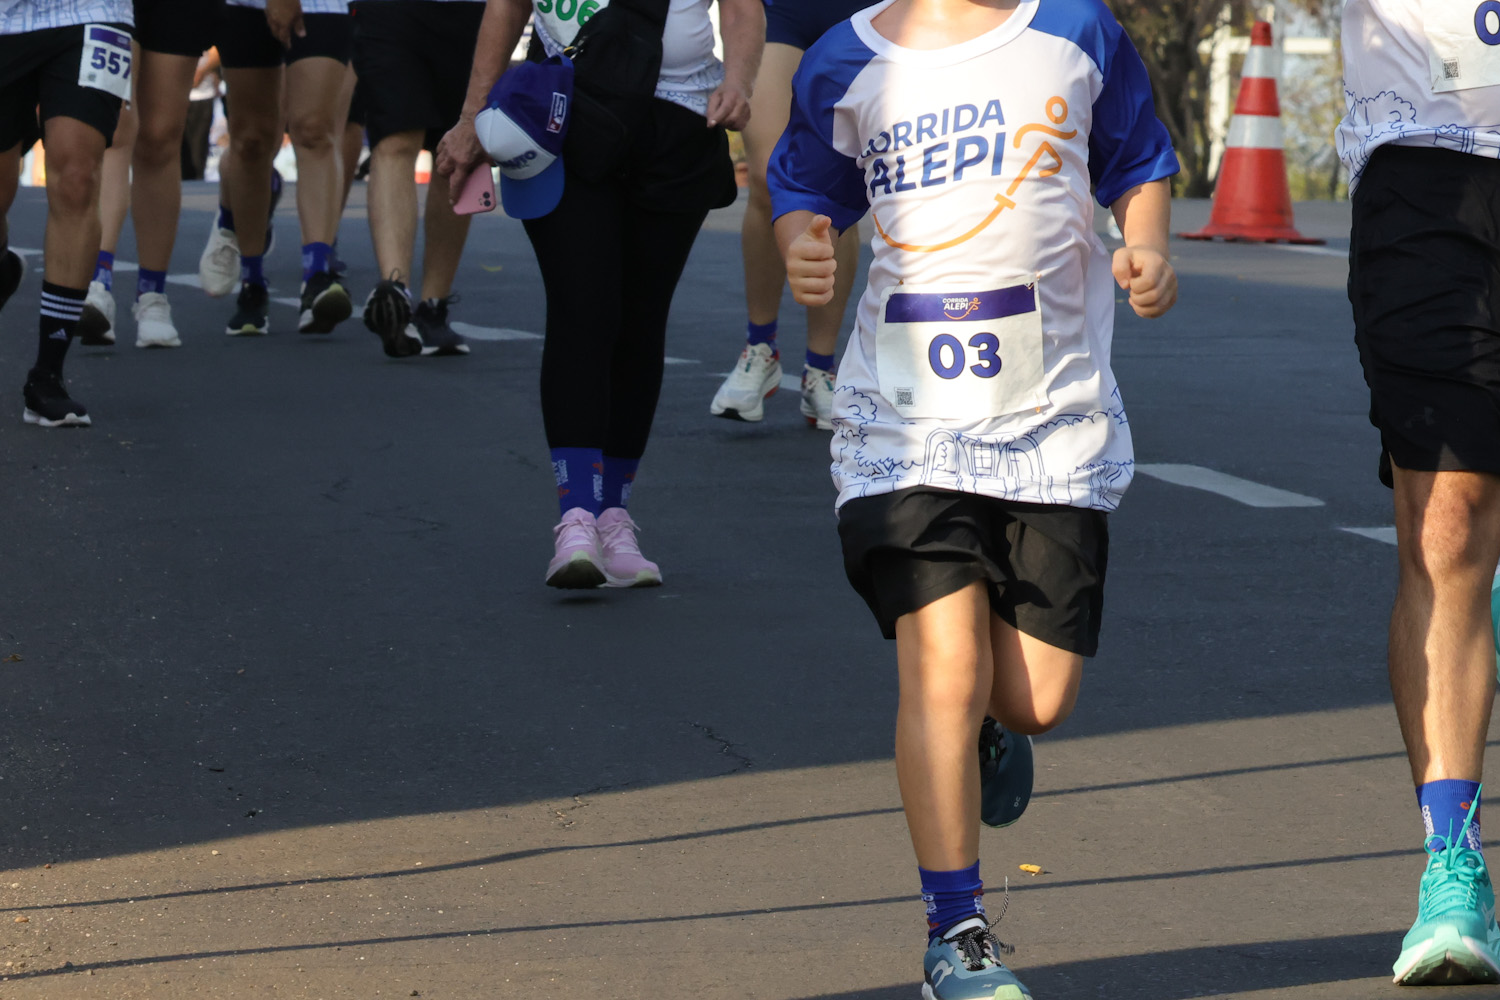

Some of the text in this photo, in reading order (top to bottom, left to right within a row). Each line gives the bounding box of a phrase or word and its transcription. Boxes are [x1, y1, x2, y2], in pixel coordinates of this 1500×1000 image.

[869, 131, 1006, 198] ALEPI
[943, 302, 969, 310] ALEPI
[928, 332, 1002, 379] 03
